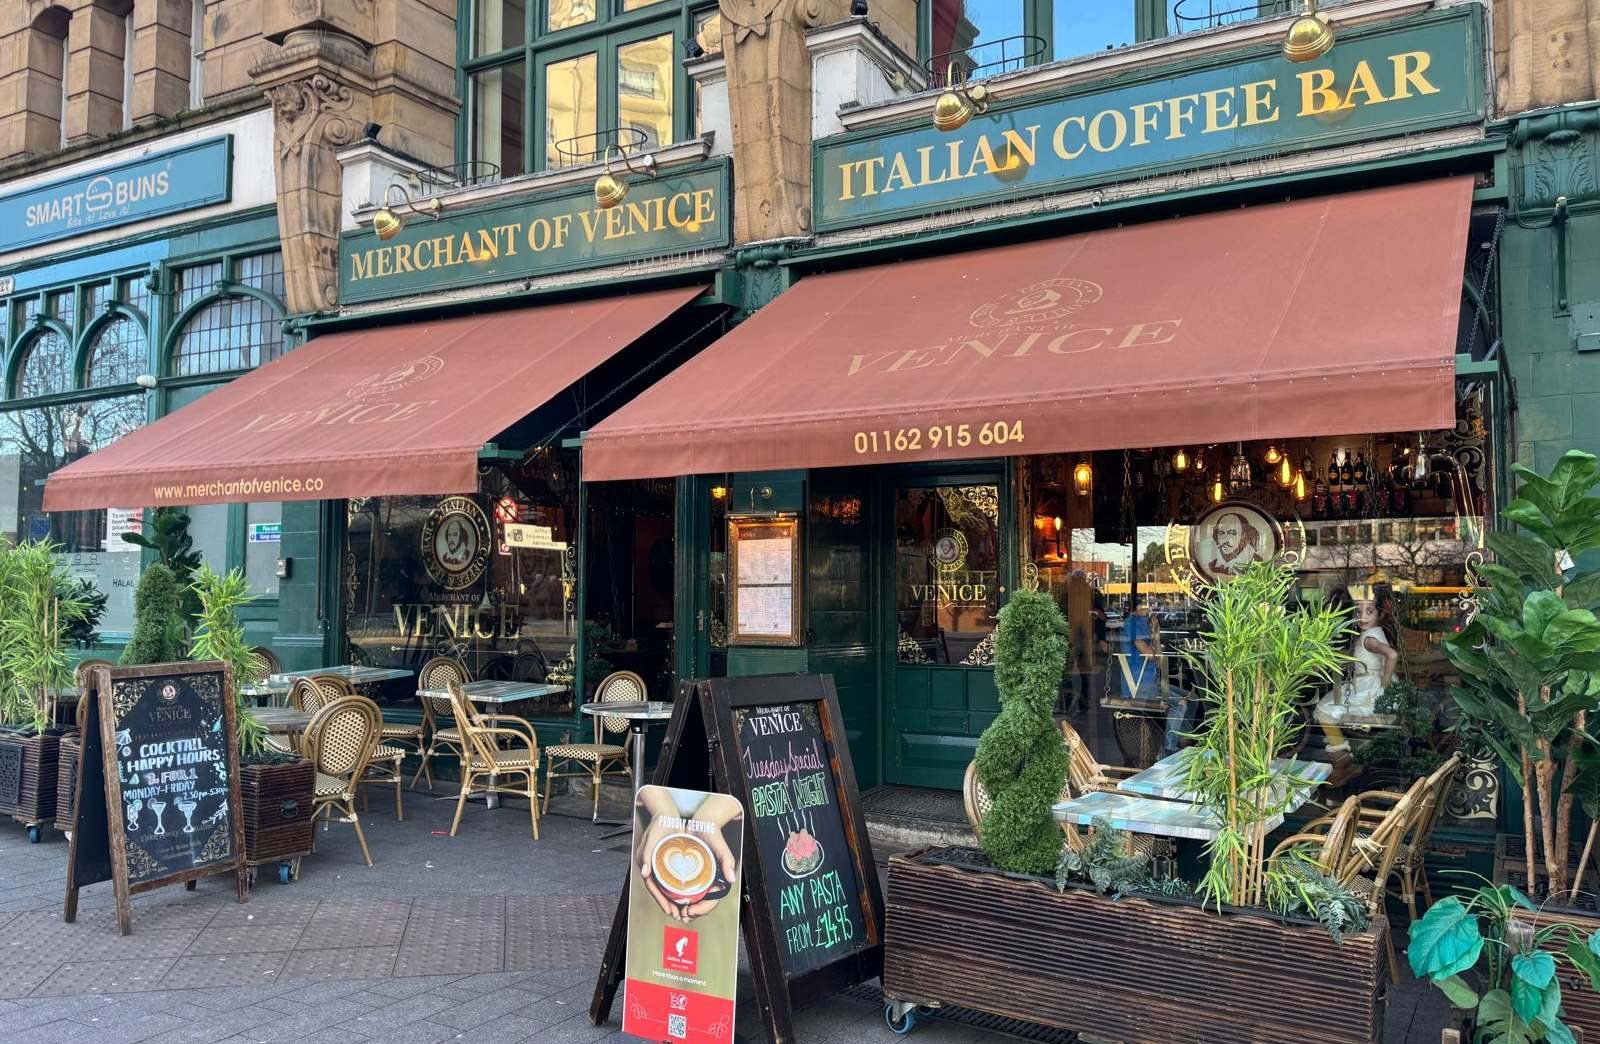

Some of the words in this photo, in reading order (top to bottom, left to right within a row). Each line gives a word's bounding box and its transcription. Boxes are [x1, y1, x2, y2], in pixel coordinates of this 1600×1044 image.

[838, 125, 1041, 201] ITALIAN
[1052, 78, 1280, 161] COFFEE
[1296, 50, 1441, 118] BAR
[26, 193, 84, 227] SMART
[116, 170, 169, 206] BUNS
[350, 223, 521, 282] MERCHANT
[527, 215, 572, 252] OF
[579, 188, 716, 244] VENICE
[847, 319, 1183, 377] VENICE
[239, 400, 439, 432] VENICE
[854, 427, 922, 454] 01162
[928, 424, 972, 448] 915
[979, 420, 1024, 446] 604
[154, 476, 324, 499] www.merchantofvenice.co
[440, 500, 479, 518] ITALIAN
[112, 578, 134, 588] HALAL
[911, 584, 987, 601] VENICE
[392, 603, 521, 639] VENICE
[149, 708, 192, 721] VENICE
[748, 713, 803, 736] VENICE
[127, 755, 174, 773] HAPPY
[176, 749, 221, 766] HOURS
[140, 738, 207, 758] COCKTAIL
[743, 746, 789, 786] Tuesday
[788, 737, 824, 779] Special
[752, 782, 793, 818] PASTA
[794, 773, 829, 813] NIGHT
[658, 815, 687, 832] PROUDLY
[688, 819, 715, 834] SERVING
[780, 882, 805, 920] ANY
[811, 870, 846, 912] PASTA
[786, 921, 813, 955] FROM
[815, 904, 853, 949] £14.95
